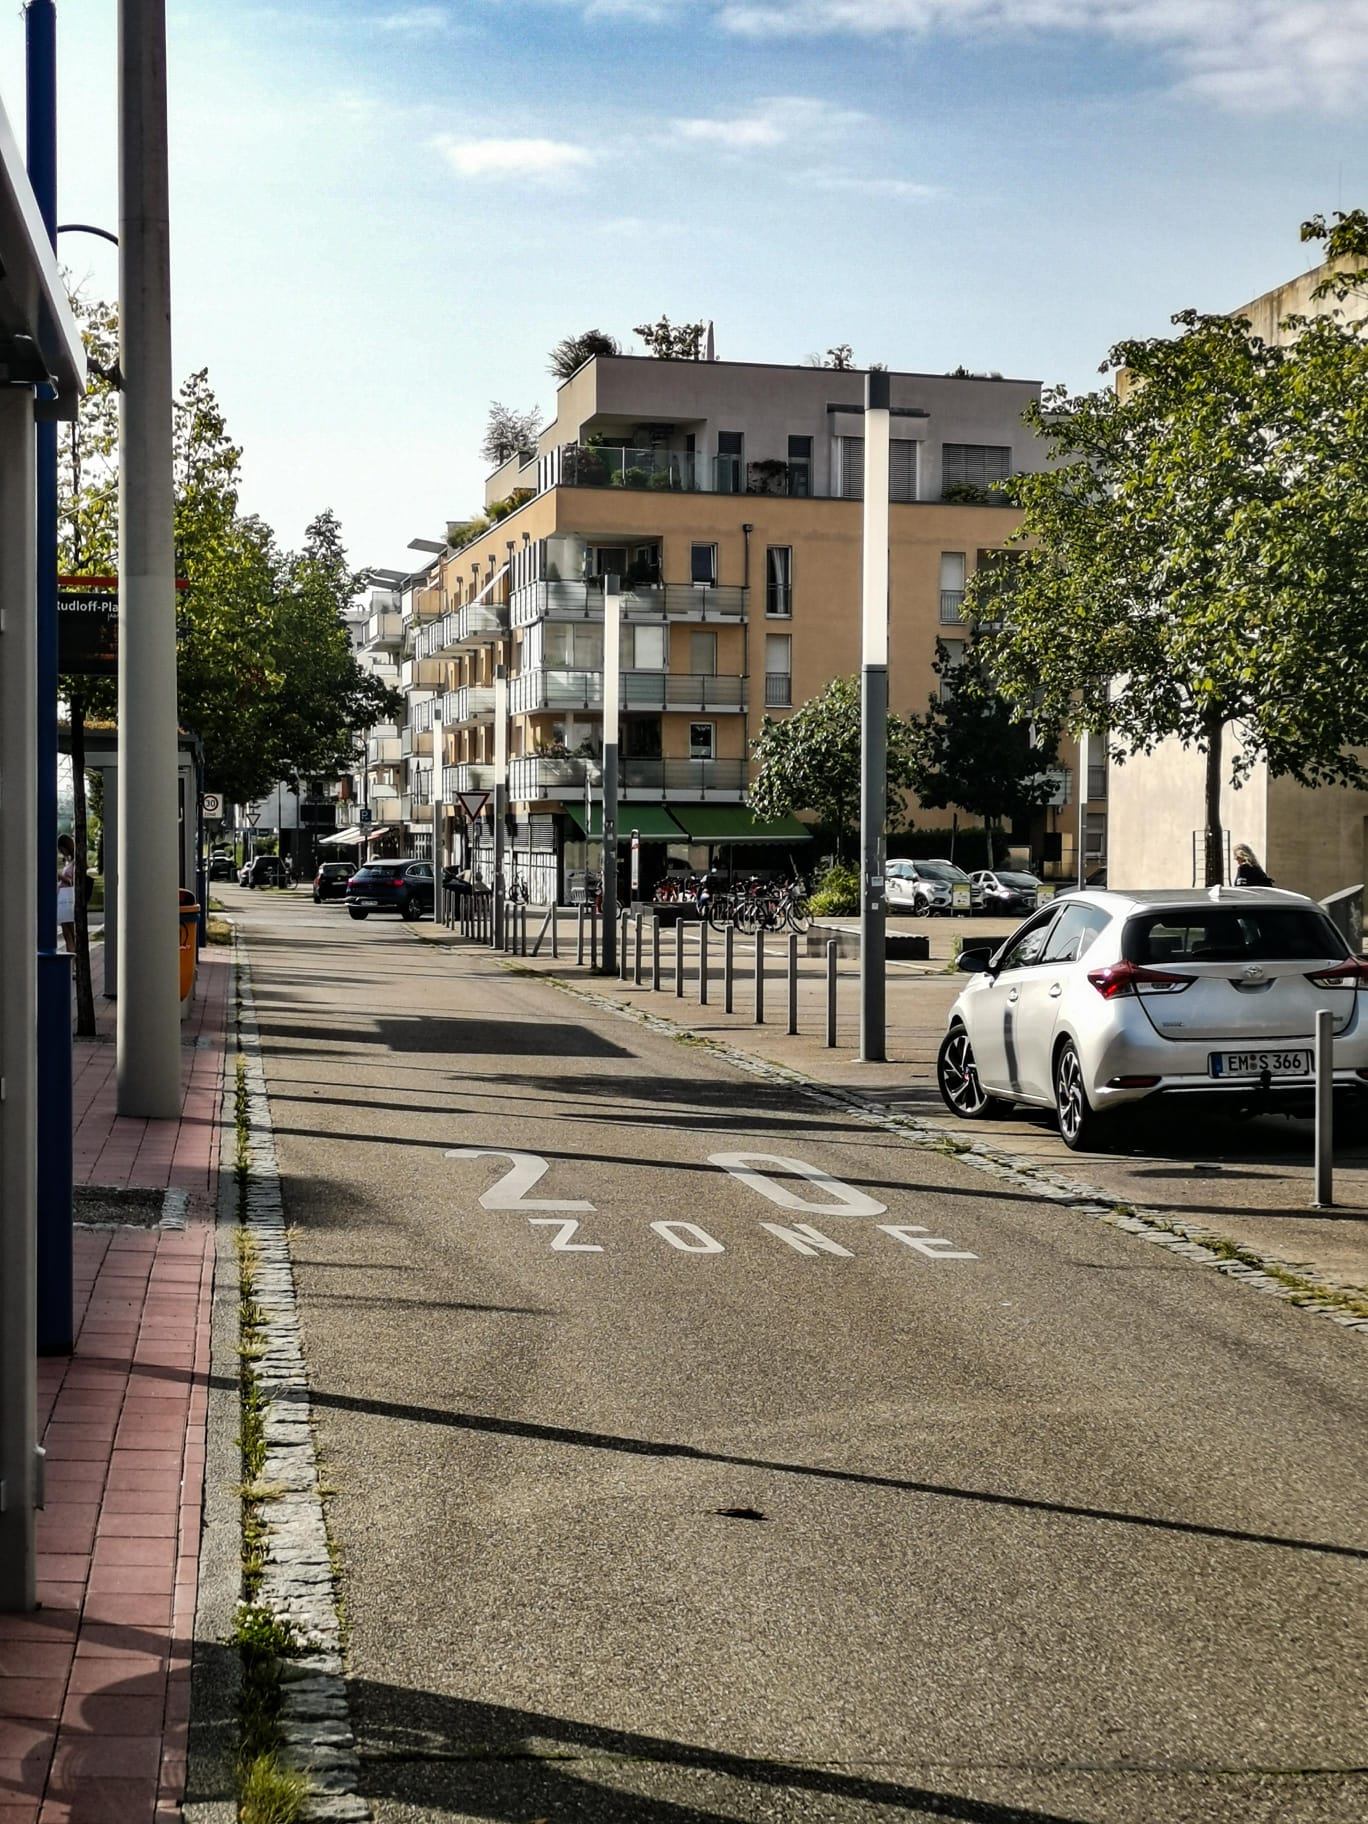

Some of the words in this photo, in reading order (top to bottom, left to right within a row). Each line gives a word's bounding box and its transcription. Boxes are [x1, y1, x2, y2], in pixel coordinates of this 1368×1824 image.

[1228, 1055, 1249, 1071] EM
[1259, 1054, 1269, 1069] S
[1273, 1053, 1302, 1069] 366
[444, 1149, 888, 1216] 20
[528, 1218, 979, 1259] ZONE
